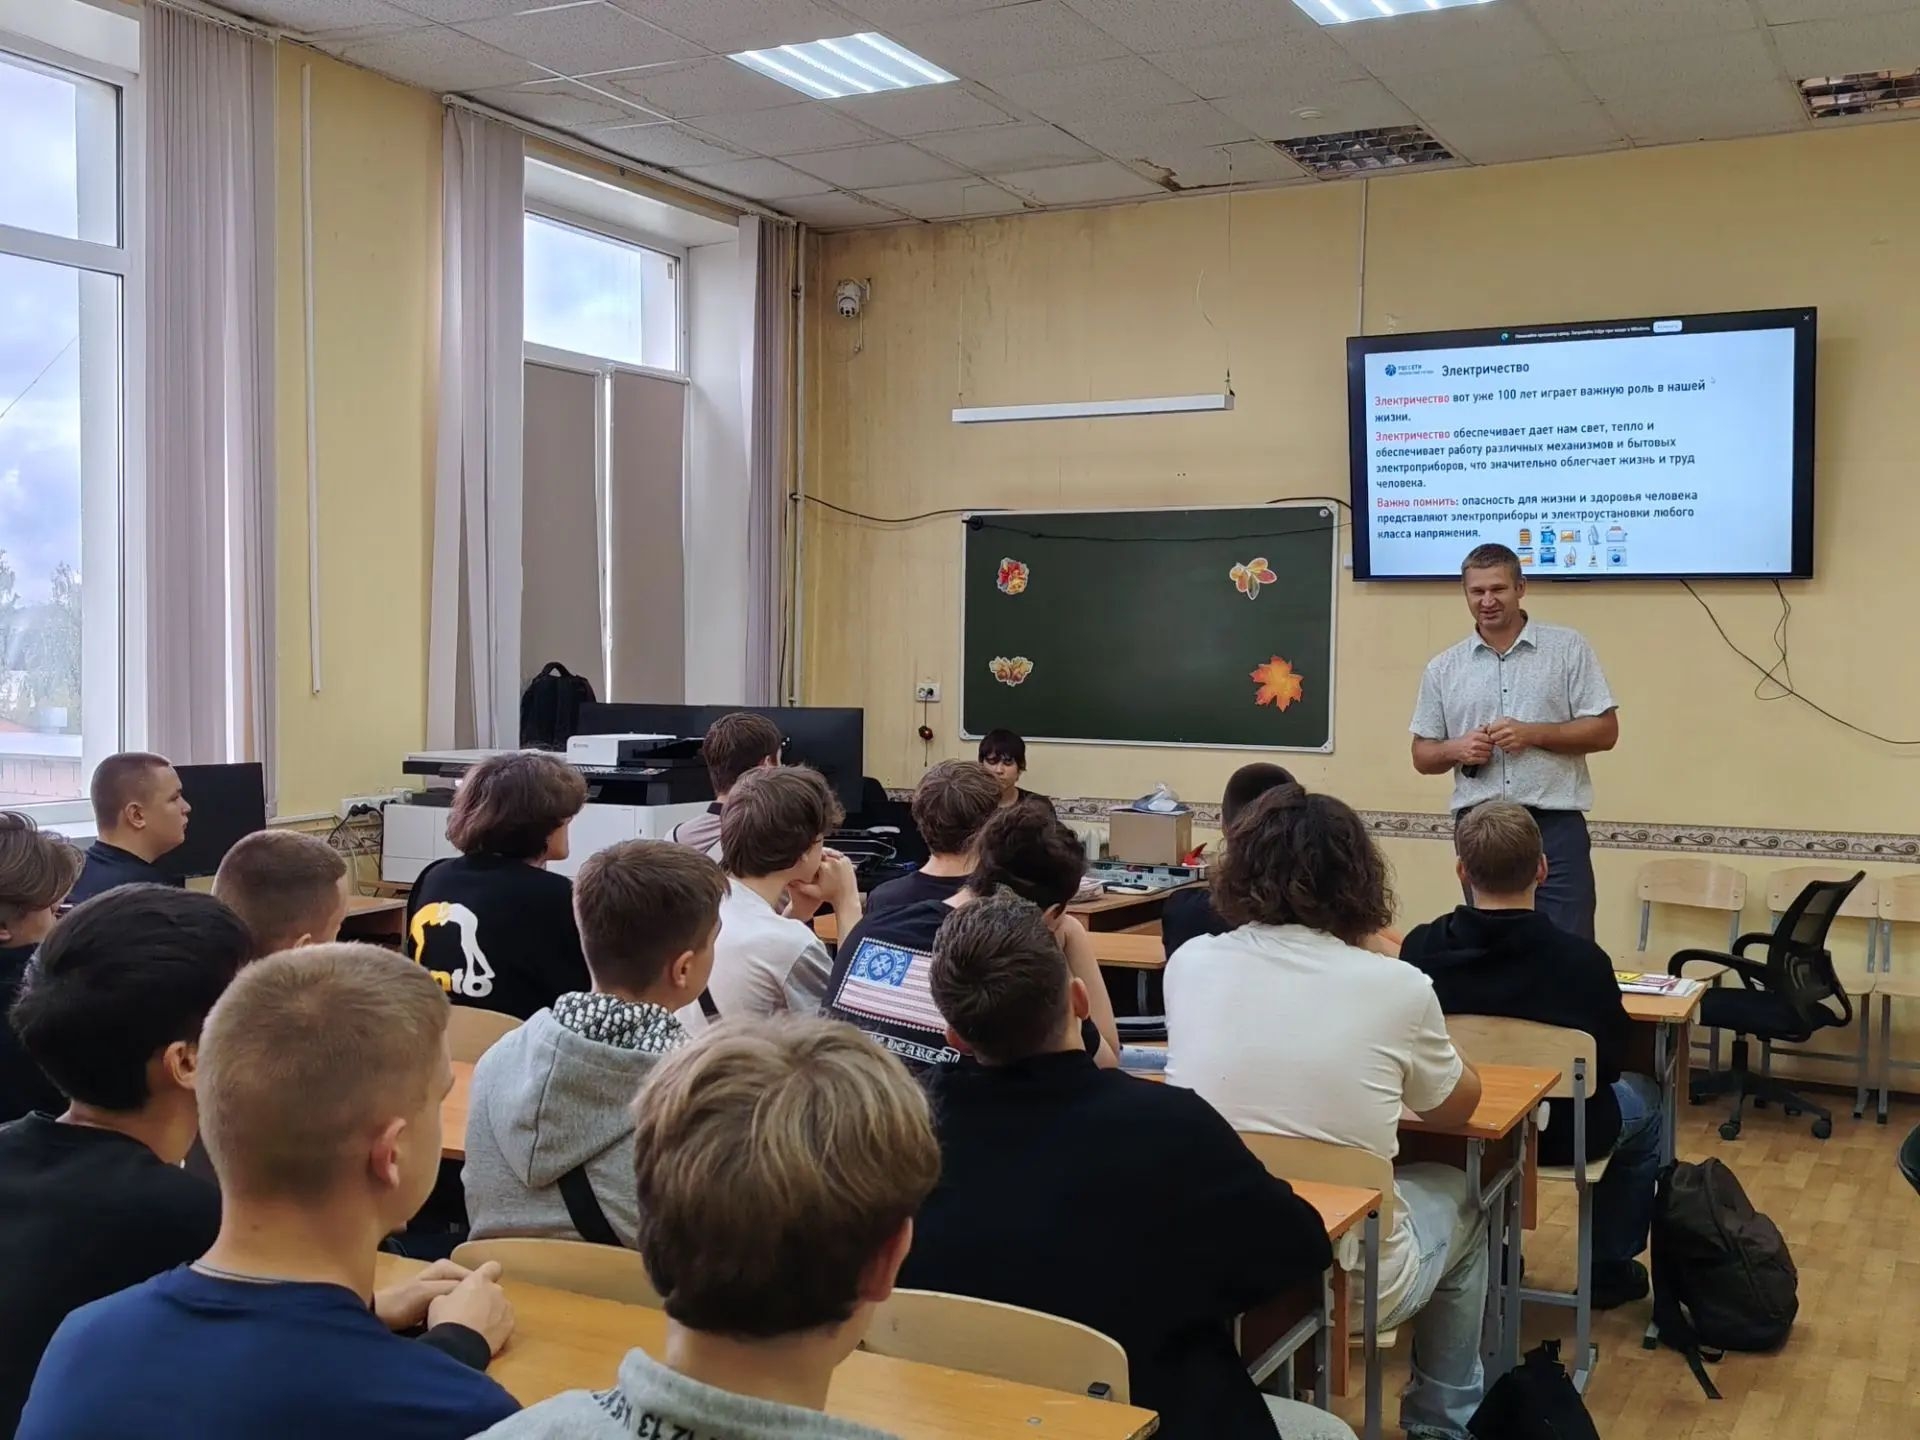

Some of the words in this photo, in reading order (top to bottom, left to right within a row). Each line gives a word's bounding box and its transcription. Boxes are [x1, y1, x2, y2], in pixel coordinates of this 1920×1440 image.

[1442, 362, 1529, 377] Электричество
[1375, 396, 1450, 407] Электричество
[1453, 395, 1469, 403] вот
[1473, 393, 1493, 403] уже
[1498, 390, 1516, 399] 100
[1520, 391, 1537, 399] лет
[1541, 389, 1577, 399] играет
[1581, 386, 1624, 399] важную
[1628, 384, 1654, 396] роль
[1667, 380, 1705, 391] нашей
[1375, 414, 1411, 422] жизни.
[1376, 431, 1450, 442] Электричество
[1454, 428, 1525, 440] обеспечивает
[1529, 426, 1553, 436] дает
[1581, 424, 1608, 434] свет,
[1612, 422, 1644, 431] тепло
[1647, 422, 1654, 430] и
[1376, 448, 1444, 459] обеспечивает
[1448, 445, 1482, 457] работу
[1486, 444, 1543, 454] различных
[1547, 440, 1613, 451] механизмов
[1617, 440, 1624, 448] и
[1628, 438, 1676, 448] бытовых
[1376, 462, 1466, 474] электроприборов,
[1471, 461, 1486, 469] что
[1490, 459, 1557, 468] значительно
[1561, 456, 1616, 467] облегчает
[1619, 456, 1655, 464] жизнь
[1670, 454, 1695, 465] труд
[1376, 479, 1426, 488] человека.
[1377, 498, 1409, 507] Важно
[1413, 497, 1458, 507] помнить:
[1462, 496, 1514, 505] опасность
[1518, 495, 1537, 506] для
[1541, 495, 1576, 503] жизни
[1580, 495, 1586, 503] и
[1590, 494, 1642, 504] здоровья
[1645, 492, 1698, 500] человека
[1377, 514, 1447, 524] представляют
[1451, 511, 1537, 522] электроприборы
[1541, 512, 1548, 520] и
[1552, 508, 1650, 521] электроустановки
[1653, 506, 1694, 517] любого
[1377, 531, 1412, 539] класса
[1415, 529, 1481, 541] напряжения.
